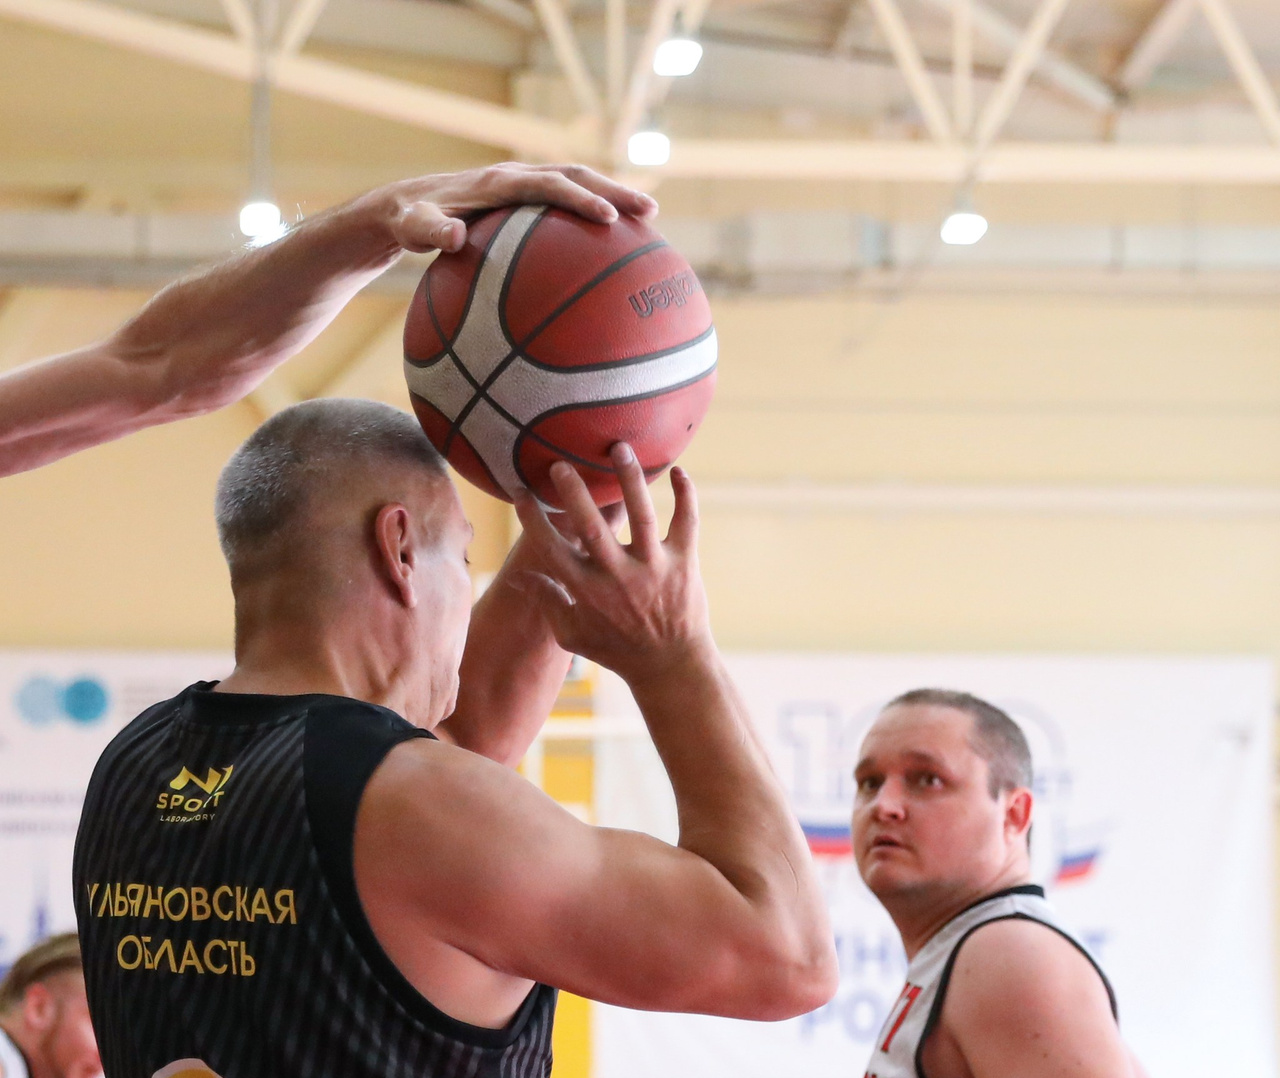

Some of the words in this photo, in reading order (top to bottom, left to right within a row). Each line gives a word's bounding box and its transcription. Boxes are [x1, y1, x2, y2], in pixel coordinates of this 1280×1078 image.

[156, 791, 225, 812] SPOT
[160, 813, 216, 823] LABORORY
[86, 882, 297, 925] УЛЬЯНОВСКАЯ
[116, 934, 256, 977] ОБЛАСТЬ
